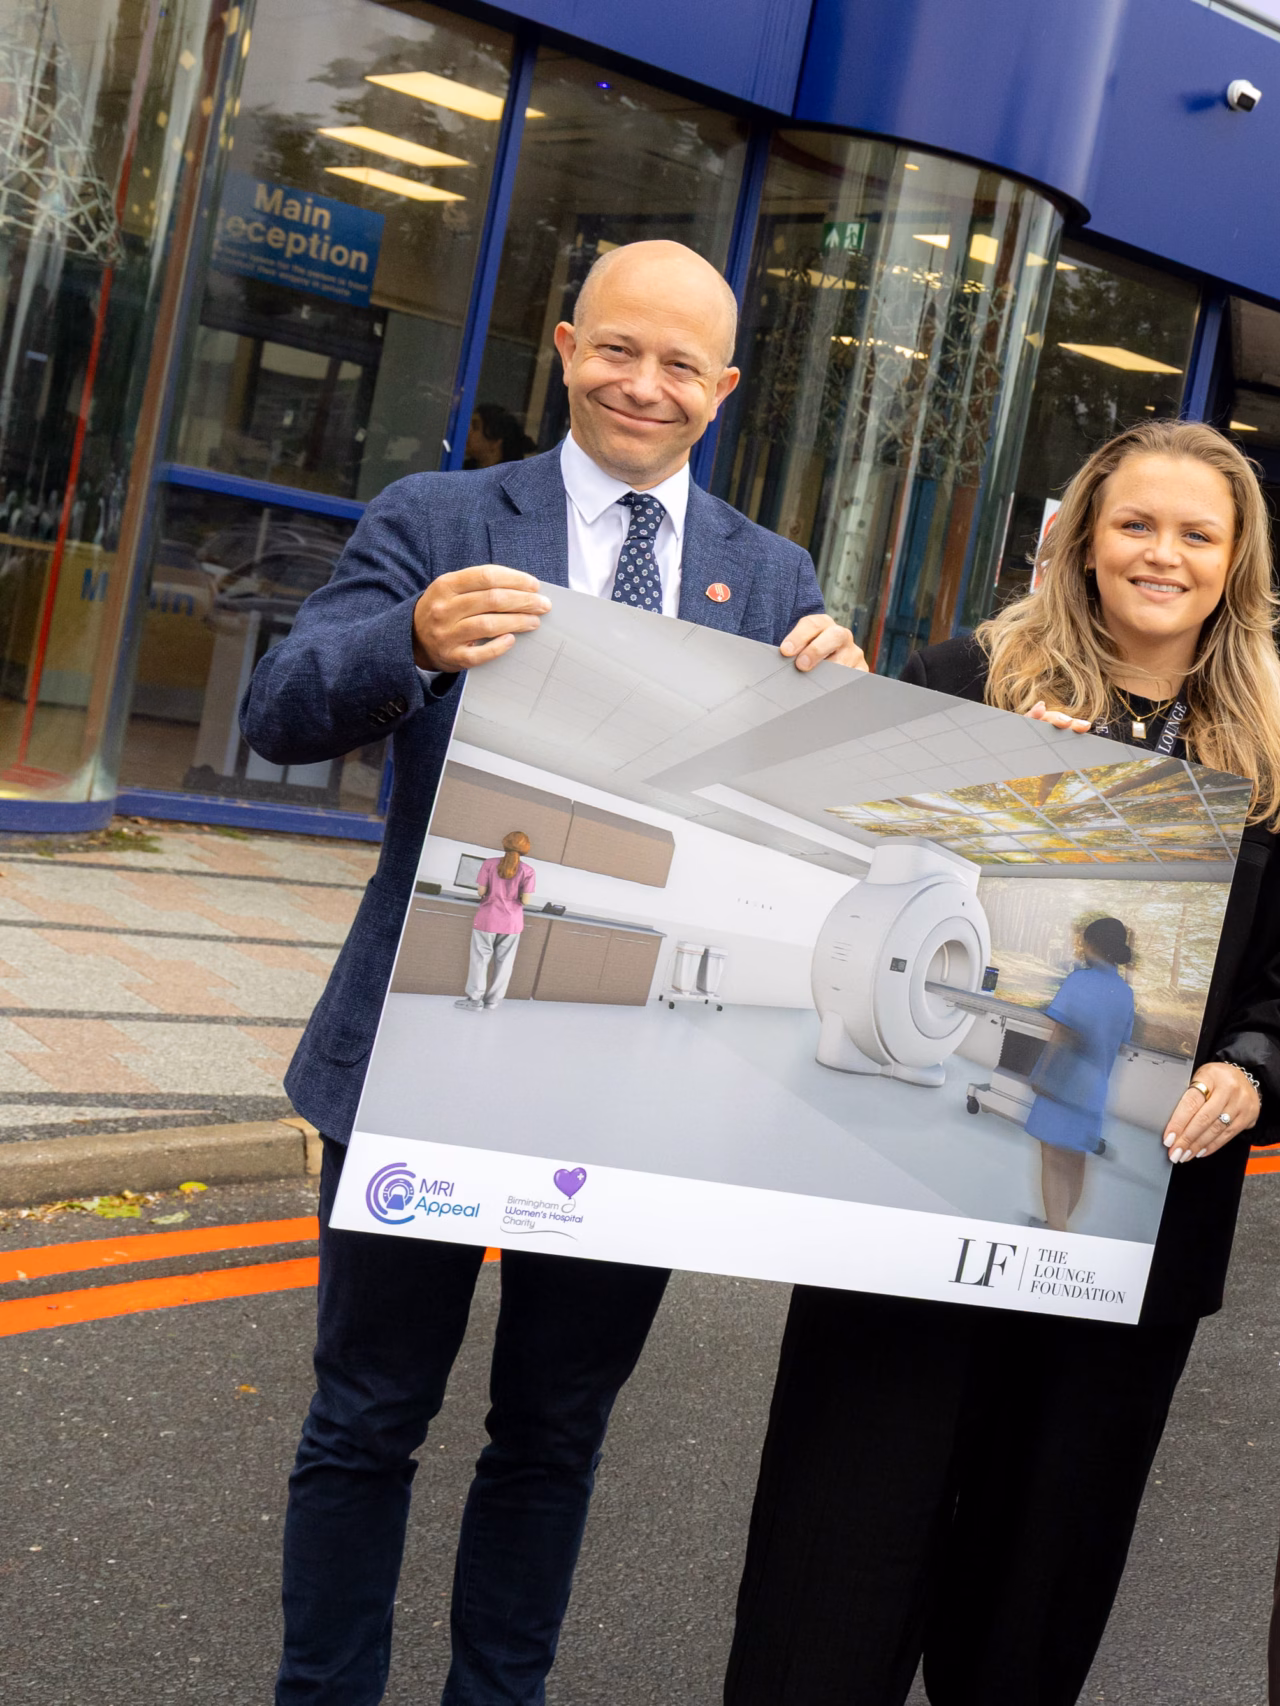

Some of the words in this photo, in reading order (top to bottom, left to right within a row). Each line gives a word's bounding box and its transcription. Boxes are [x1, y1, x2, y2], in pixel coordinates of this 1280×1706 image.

[254, 183, 331, 230] Main
[1157, 701, 1187, 754] LOUNGE
[419, 1178, 454, 1197] MRI
[414, 1196, 480, 1218] Appeal
[507, 1196, 559, 1211] Birmingham
[503, 1215, 535, 1230] Charity
[505, 1206, 547, 1220] Women's
[549, 1211, 583, 1224] Hospital
[948, 1237, 1017, 1288] LF
[1038, 1248, 1069, 1265] THE
[1033, 1265, 1096, 1285] LOUNGE
[1030, 1280, 1127, 1304] FOUNDATION
